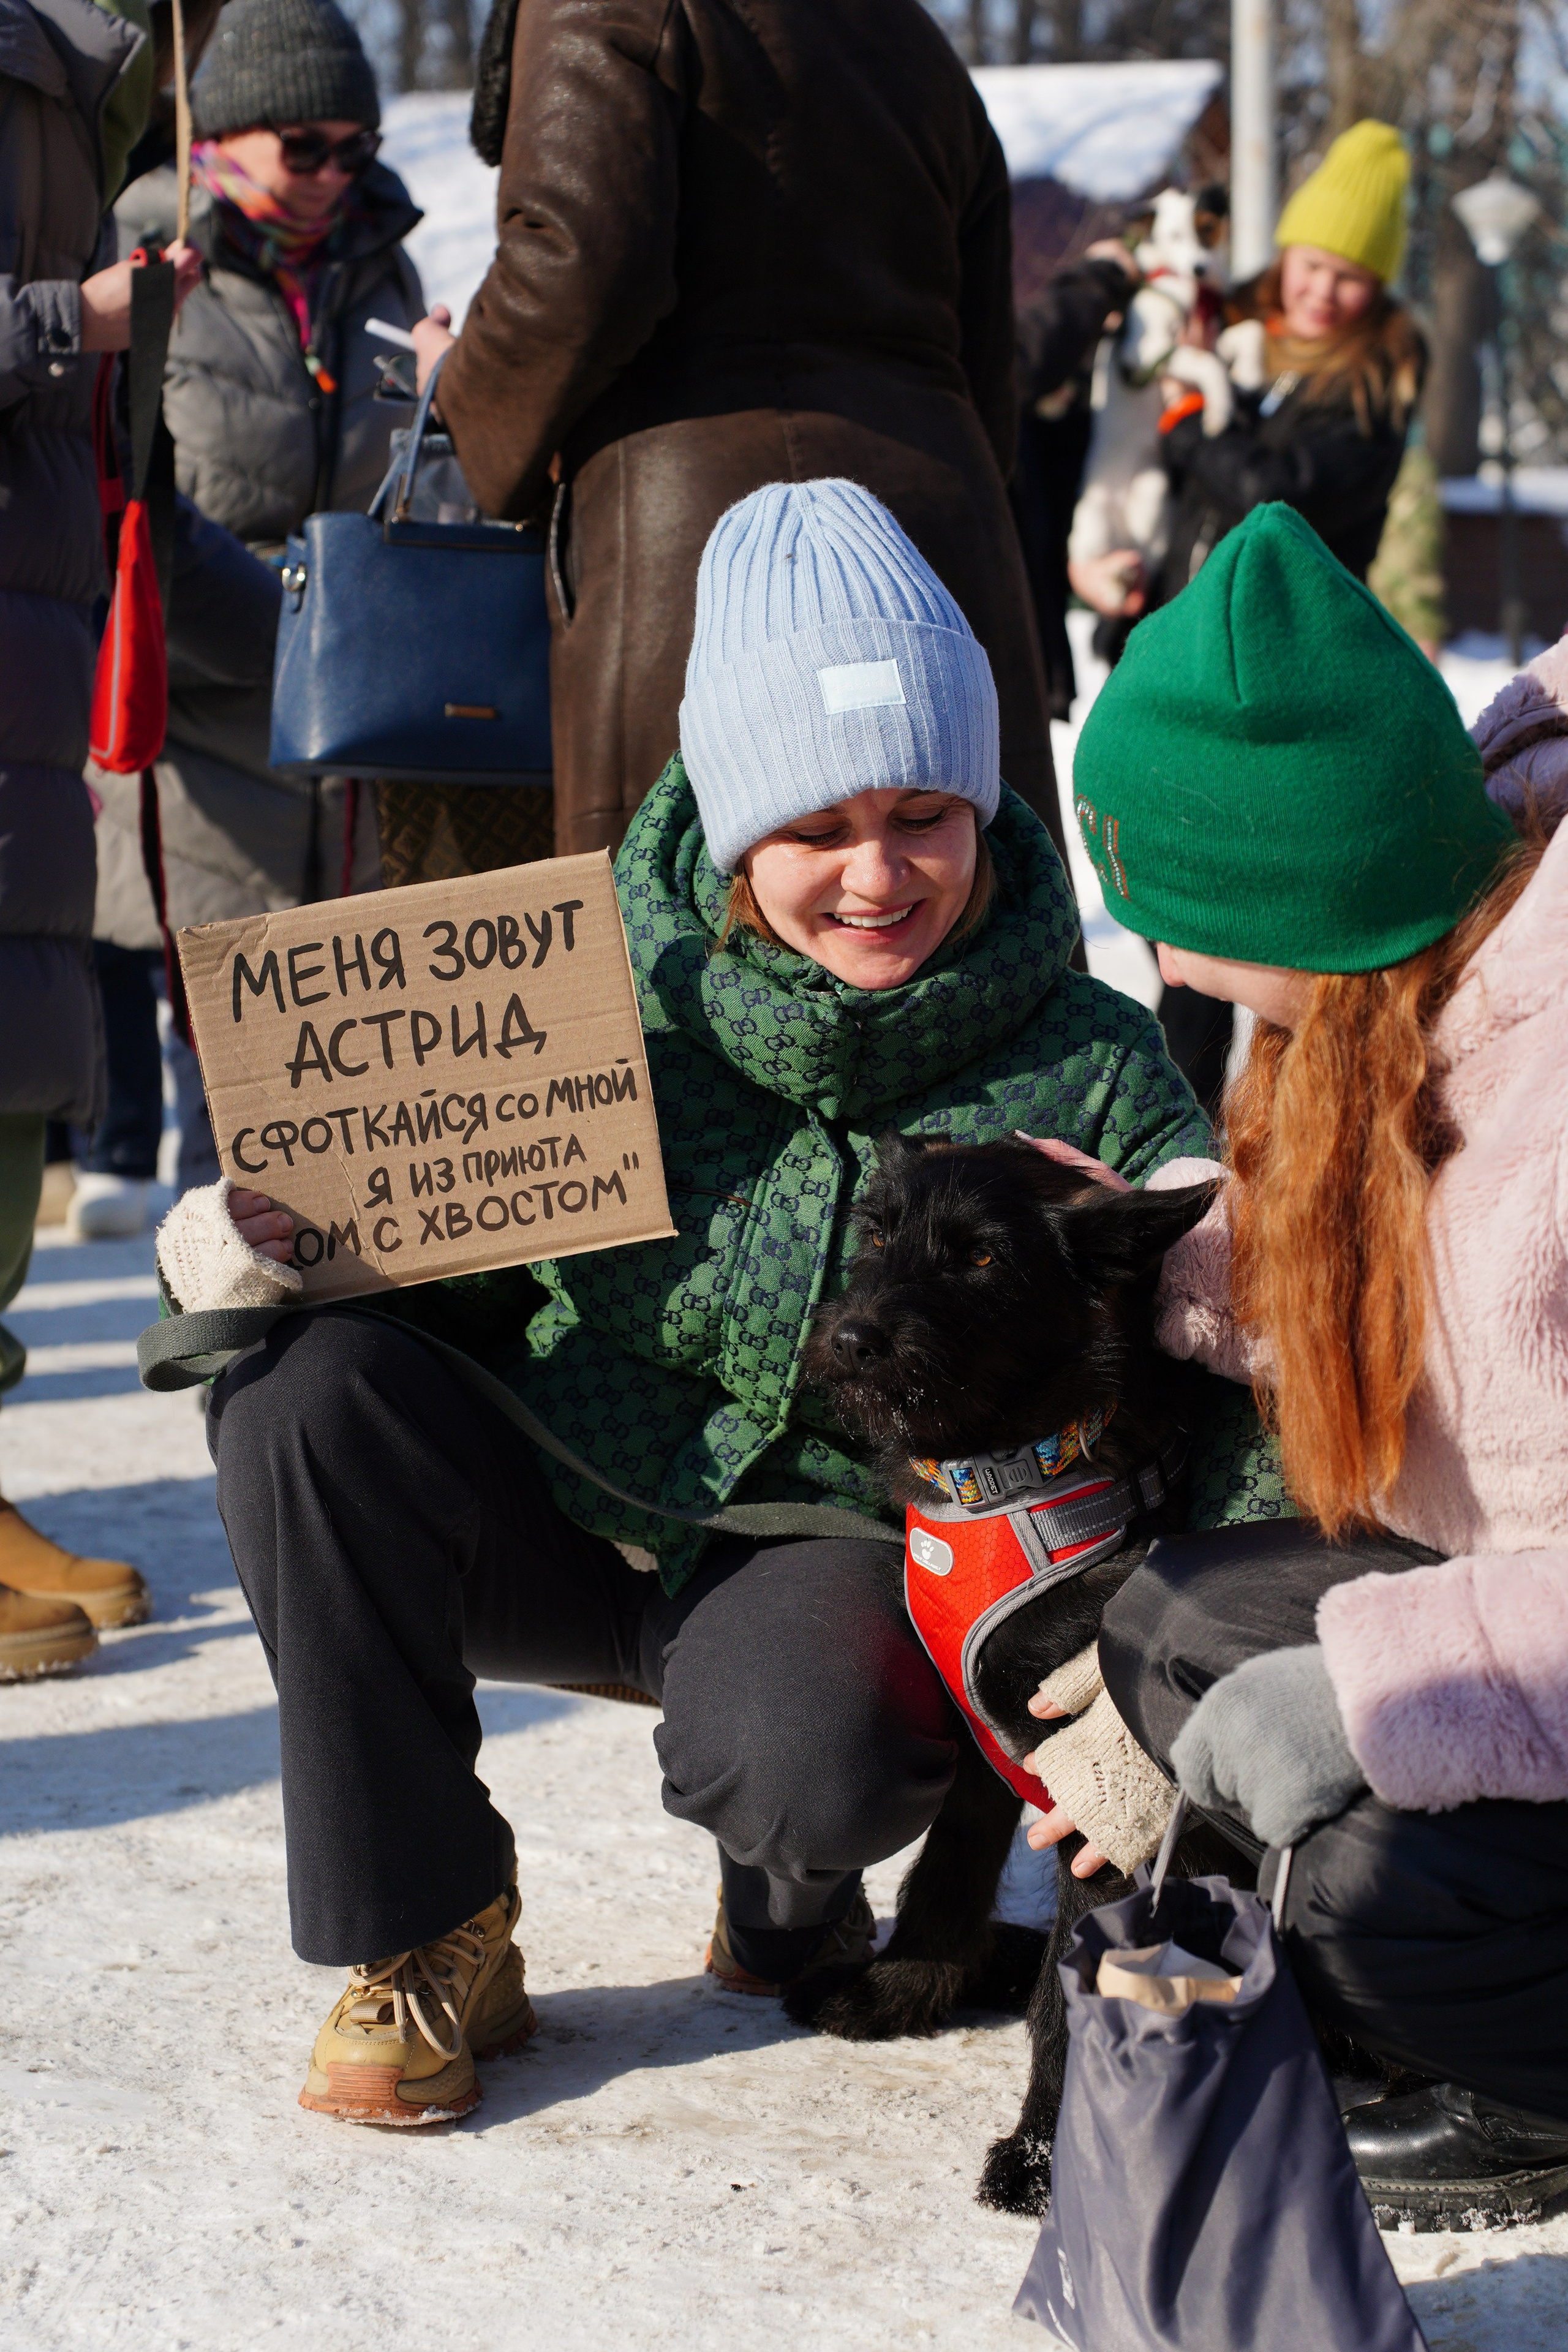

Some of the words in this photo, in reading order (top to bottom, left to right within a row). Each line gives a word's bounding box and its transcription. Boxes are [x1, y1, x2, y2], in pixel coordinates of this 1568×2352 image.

[232, 927, 407, 1023] МЕНЯ
[422, 899, 584, 981] ЗОВУТ
[284, 993, 547, 1089] АСТРИД
[231, 1089, 489, 1174] СФОТКАЙСЯ
[546, 1058, 638, 1118] МНОЙ
[363, 1166, 393, 1209] Я
[409, 1157, 456, 1198] ИЗ
[462, 1133, 588, 1188] ПРИЮТА
[285, 1217, 362, 1271] ОМ
